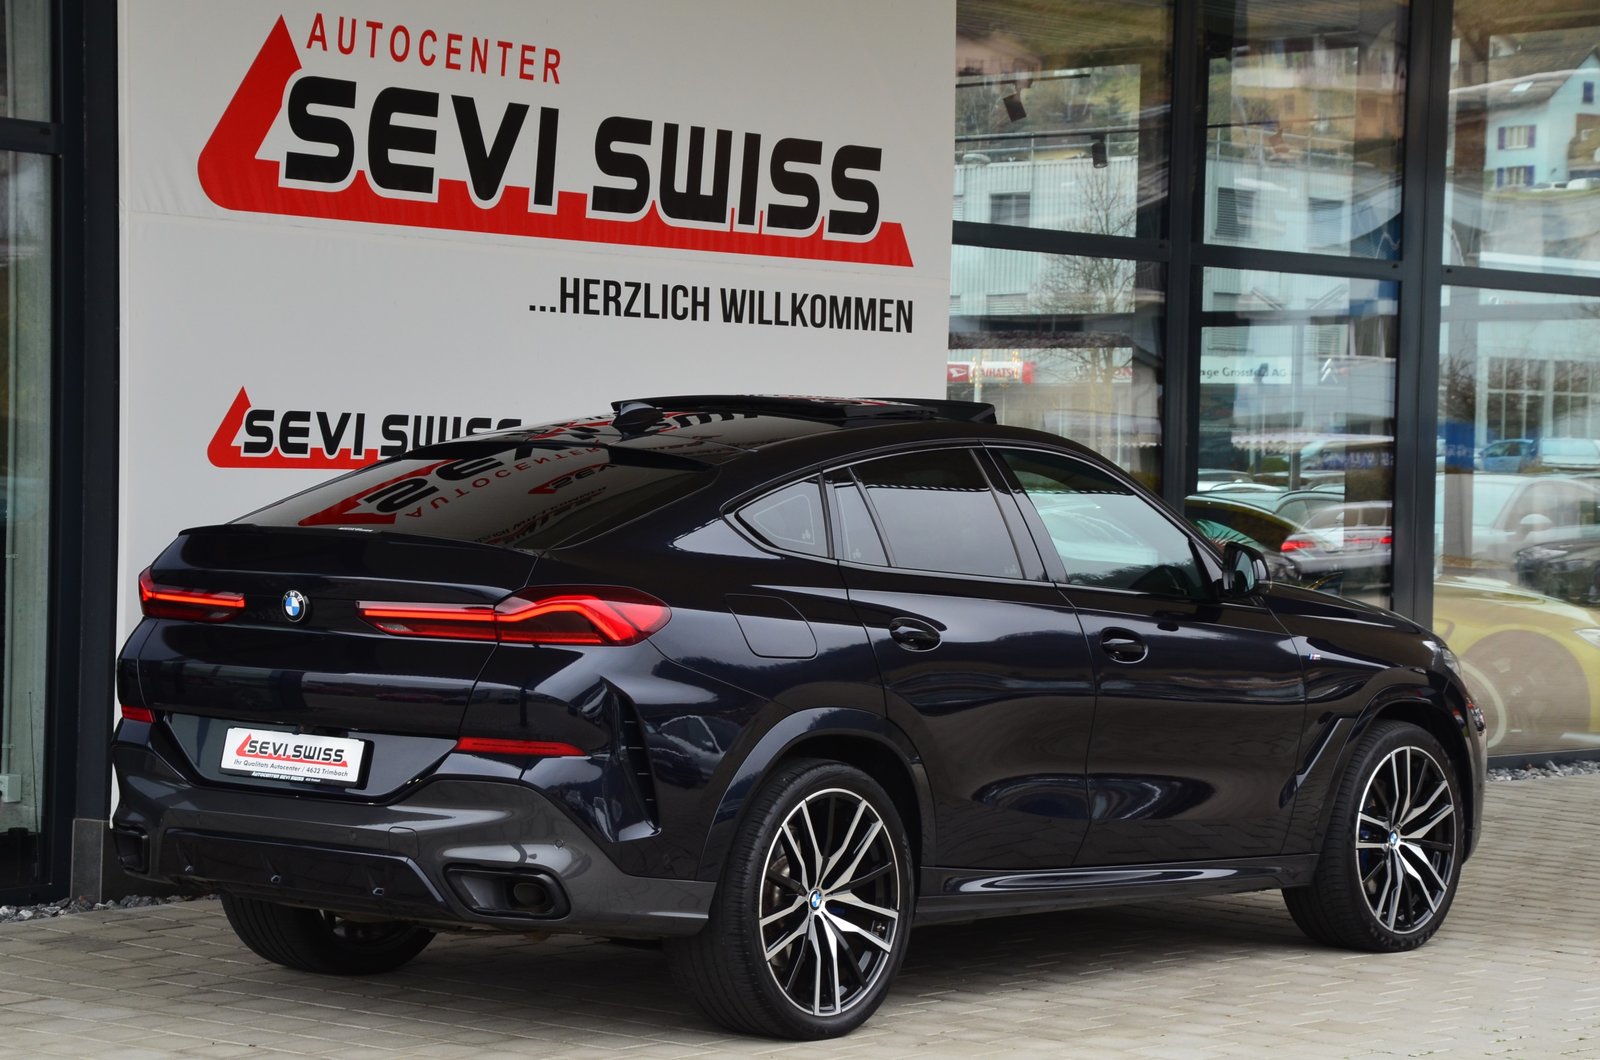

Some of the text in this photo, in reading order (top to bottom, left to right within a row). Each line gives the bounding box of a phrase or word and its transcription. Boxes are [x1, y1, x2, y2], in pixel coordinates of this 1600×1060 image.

[306, 12, 561, 84] AUTOCENTER
[285, 75, 882, 238] SEVI SWISS
[720, 288, 913, 333] WILLKOMMEN
[1222, 366, 1268, 377] Grossfd
[243, 409, 365, 456] SEVI
[247, 740, 344, 762] SEVI SWISS
[270, 763, 300, 772] Autocenter
[322, 768, 348, 777] Trimbach
